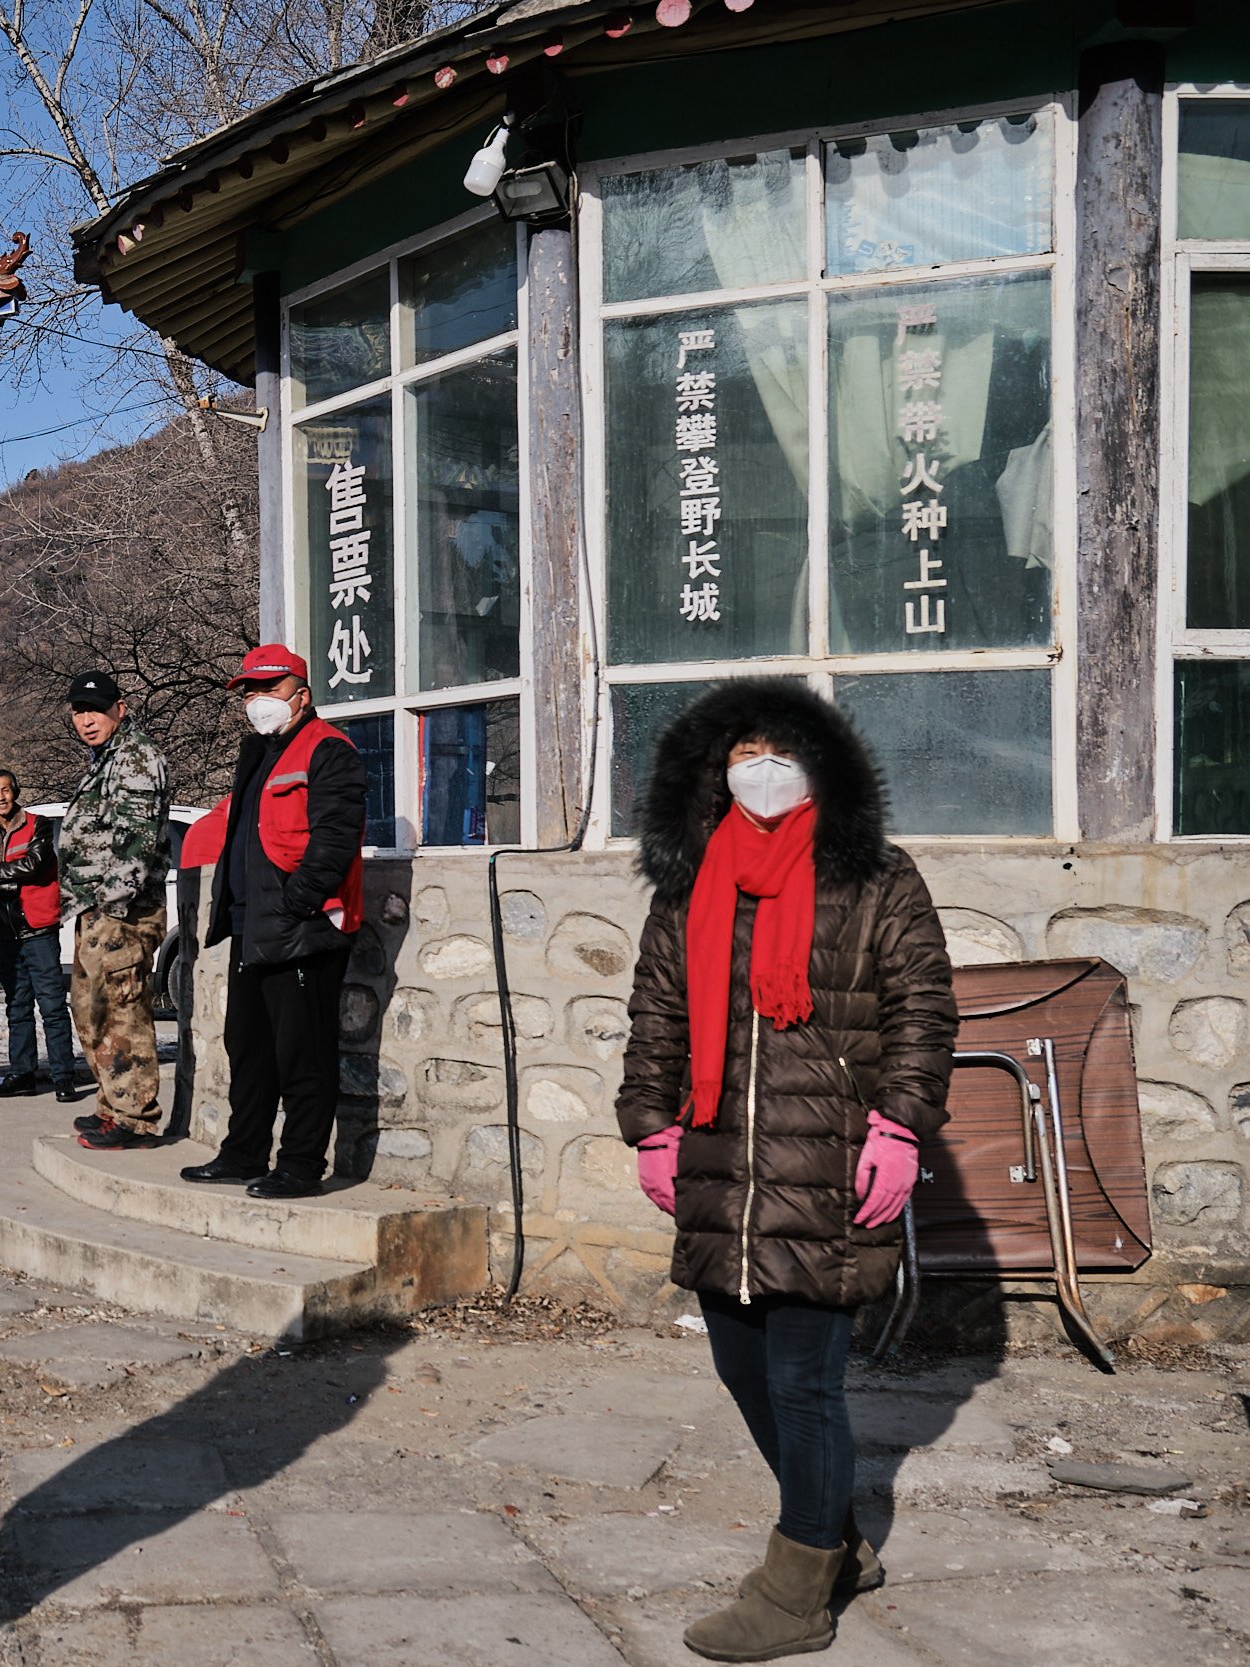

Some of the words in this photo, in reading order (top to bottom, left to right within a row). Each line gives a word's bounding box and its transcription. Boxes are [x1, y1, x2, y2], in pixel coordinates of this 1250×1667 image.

[325, 460, 374, 689] 售票处
[675, 329, 722, 622] 严禁攀登野长城
[897, 303, 948, 634] 严禁带火种上山
